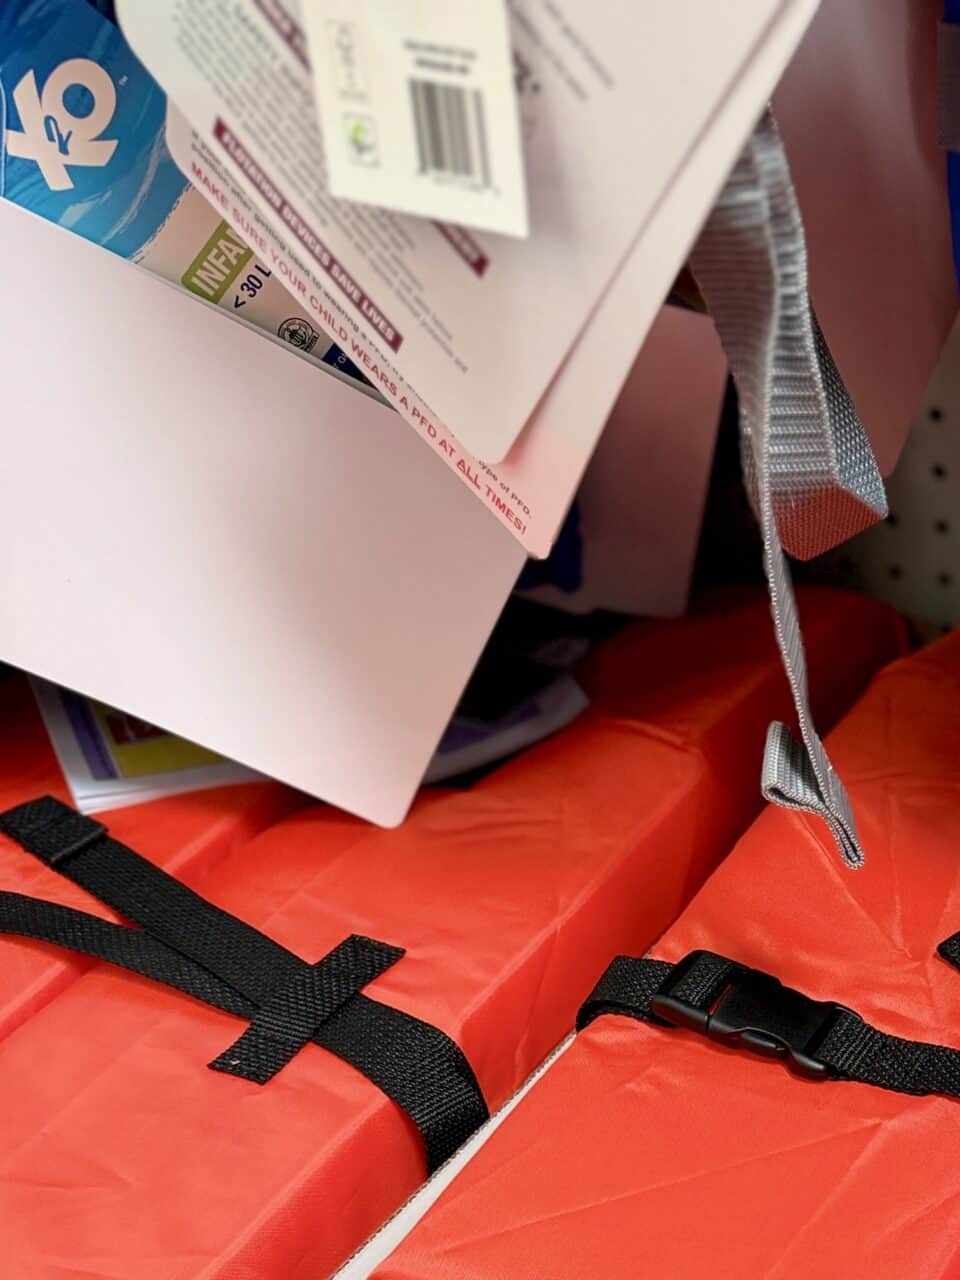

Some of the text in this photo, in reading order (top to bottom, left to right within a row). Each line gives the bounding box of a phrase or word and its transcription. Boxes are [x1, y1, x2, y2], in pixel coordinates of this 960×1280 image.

[240, 274, 263, 298] 30
[282, 204, 332, 268] DEVICES
[331, 263, 362, 303] SAVE
[361, 298, 396, 342] LIVES
[191, 161, 229, 206] MAKE
[231, 207, 268, 250] SURE
[271, 250, 307, 297] YOUR
[309, 295, 349, 342] CHILD
[351, 340, 398, 397] WEARS
[399, 396, 409, 410] A
[411, 406, 437, 438] PFD
[438, 439, 456, 457] AT
[456, 458, 482, 490] ALL
[485, 484, 527, 534] TIMES!
[499, 481, 510, 494] of
